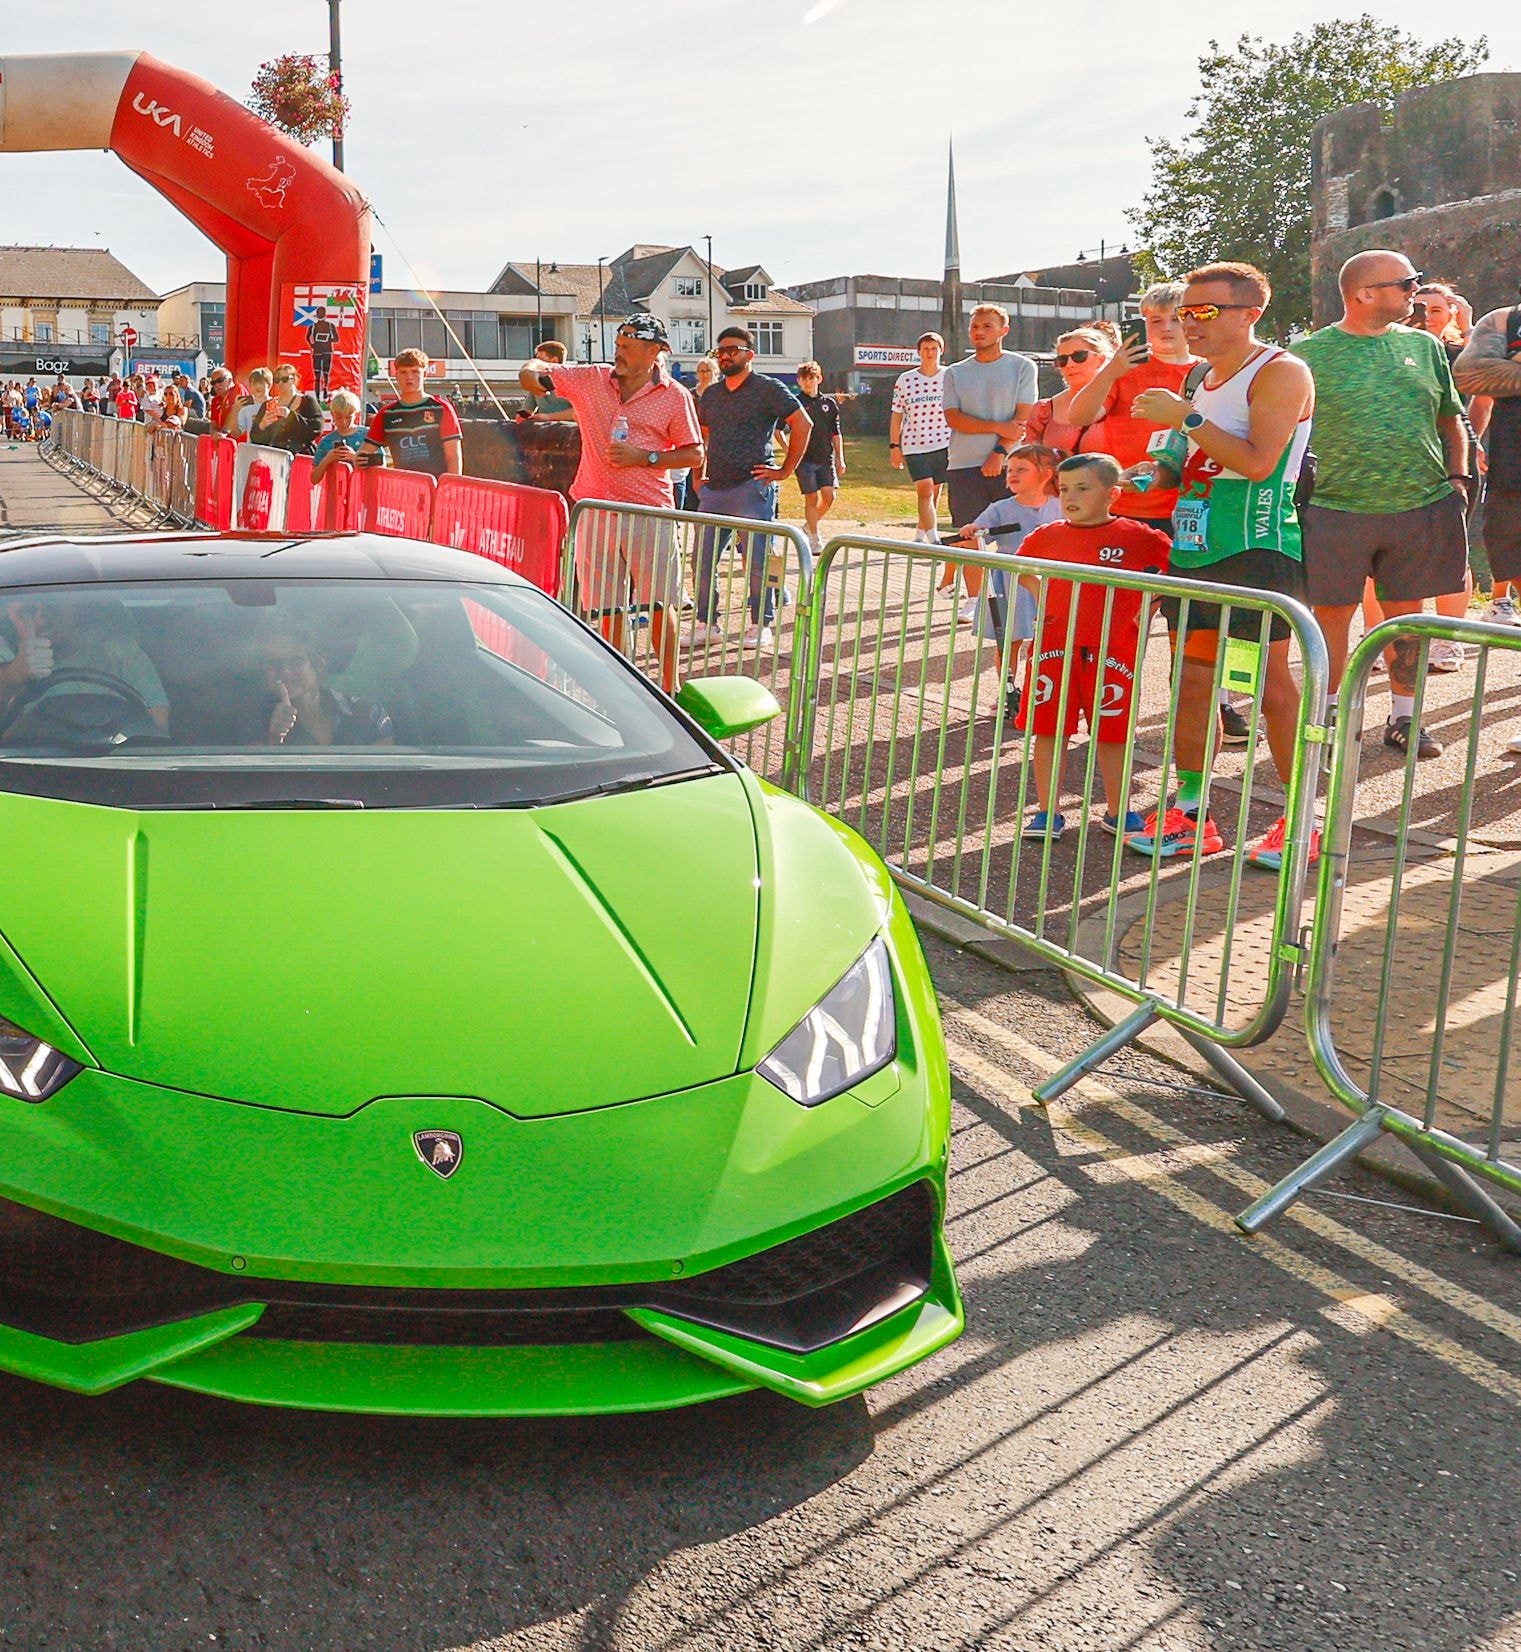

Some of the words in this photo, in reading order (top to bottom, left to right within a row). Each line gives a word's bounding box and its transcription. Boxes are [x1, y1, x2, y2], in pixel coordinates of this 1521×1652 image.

[132, 91, 181, 138] UKA
[193, 126, 214, 143] UNITED
[186, 138, 215, 159] ATHLETICS
[36, 358, 70, 372] Bagz
[400, 434, 427, 449] CLC
[1255, 488, 1274, 539] WALES
[1176, 519, 1198, 532] 118
[1099, 547, 1125, 563] 92
[1150, 830, 1186, 845] BOOKS
